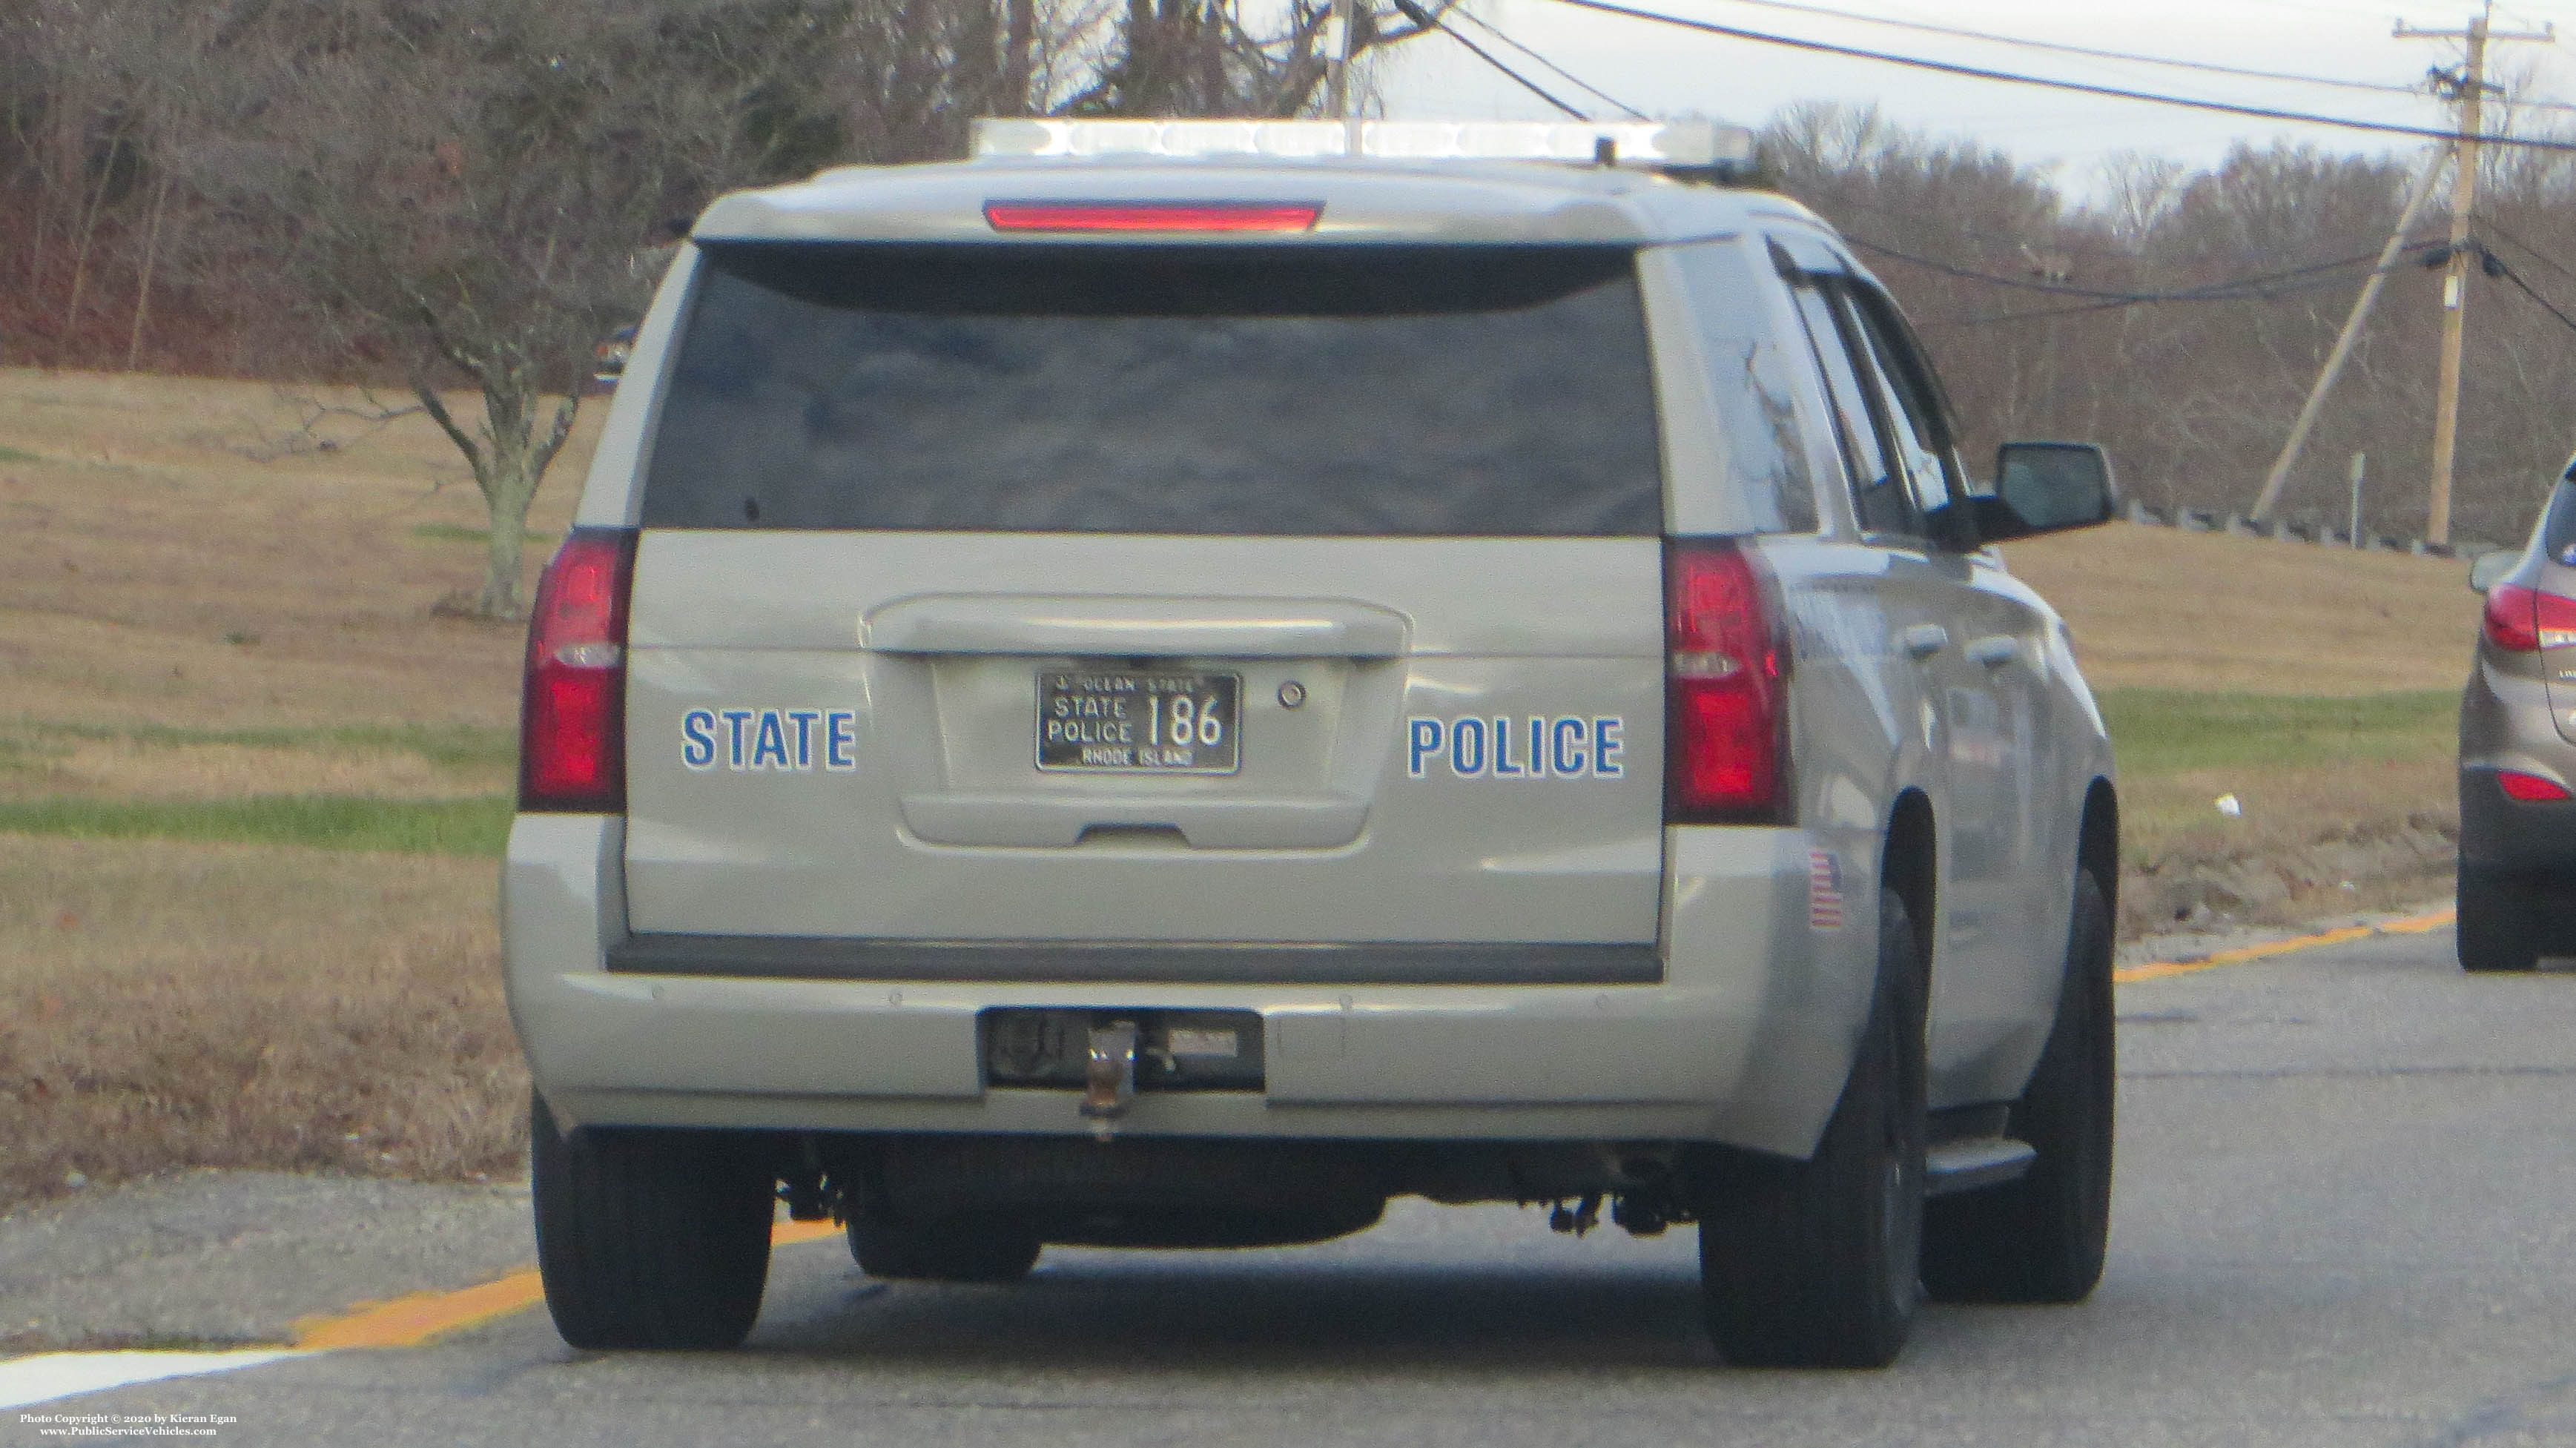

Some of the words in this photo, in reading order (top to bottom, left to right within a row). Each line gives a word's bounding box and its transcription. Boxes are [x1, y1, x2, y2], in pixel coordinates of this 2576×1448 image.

[1054, 695, 1128, 718] STATE
[1149, 695, 1222, 746] 186
[682, 709, 856, 770] STATE
[1047, 719, 1132, 743] POLICE
[1408, 717, 1624, 778] POLICE
[1082, 747, 1133, 766] RHODE
[1138, 747, 1193, 766] ISLAND
